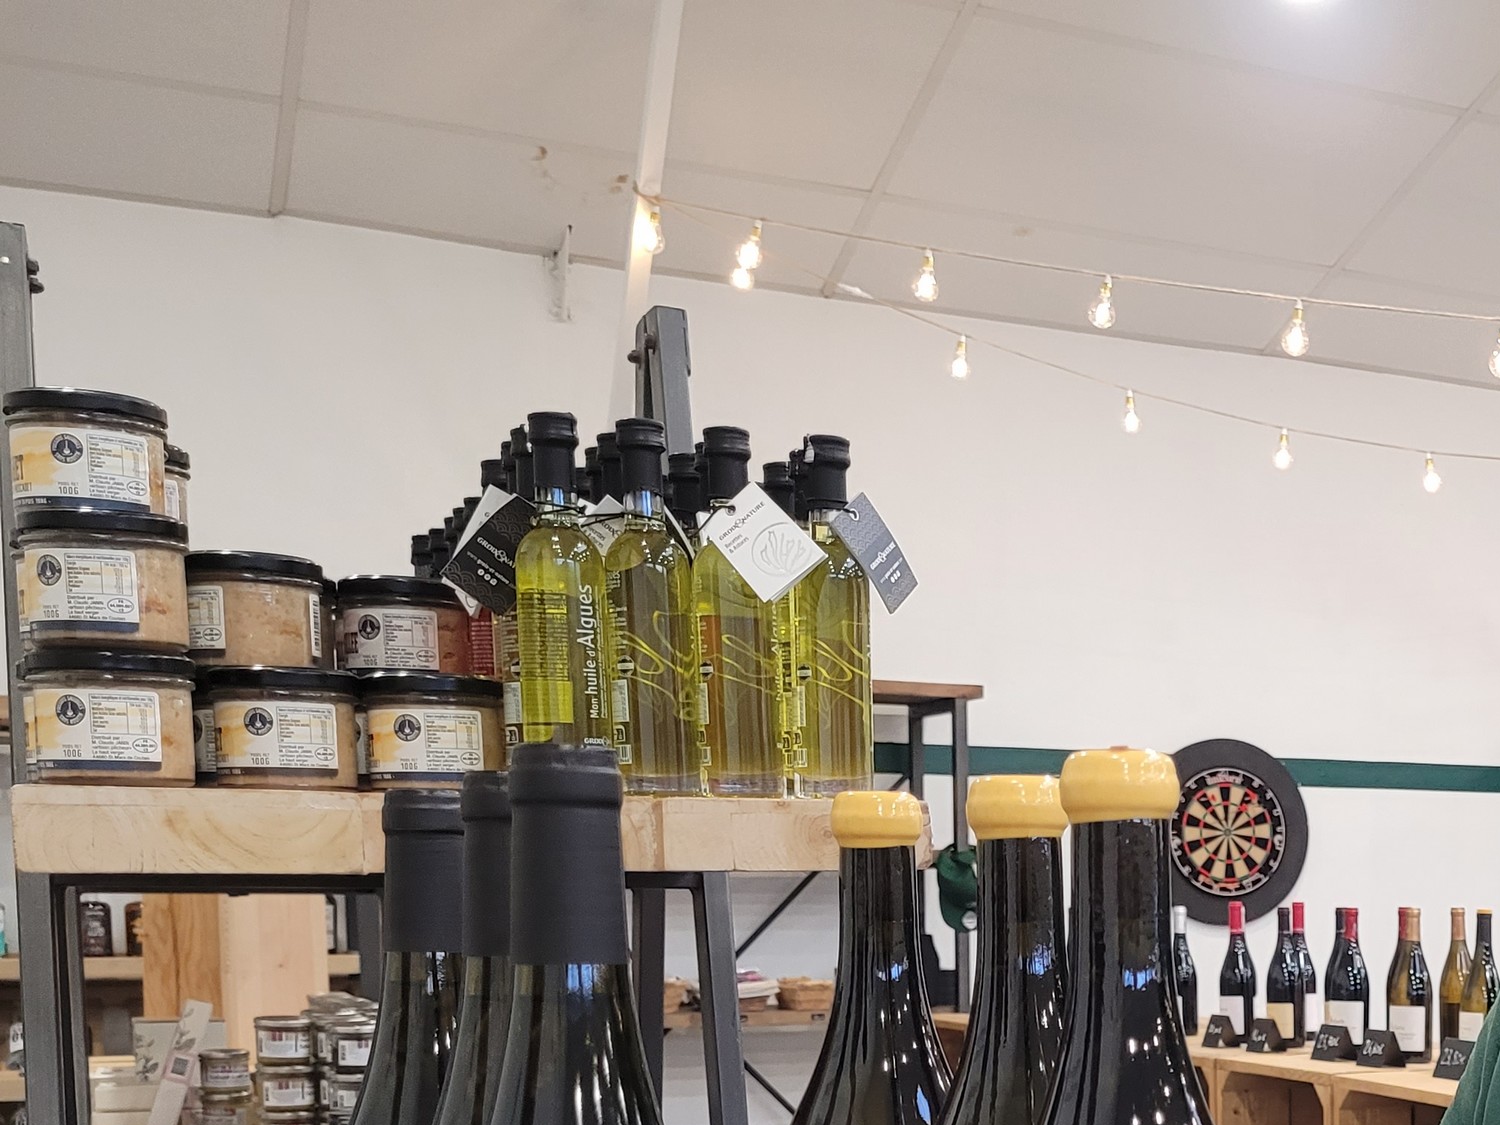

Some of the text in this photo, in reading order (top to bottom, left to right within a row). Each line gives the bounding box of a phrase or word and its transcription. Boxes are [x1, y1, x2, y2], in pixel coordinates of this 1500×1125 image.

[59, 486, 79, 495] 100G
[743, 501, 765, 521] NATURE
[43, 610, 60, 618] 100G
[583, 658, 599, 696] huile
[590, 697, 600, 719] Mon
[63, 749, 82, 758] 100G
[251, 757, 270, 765] 100G
[400, 762, 418, 770] 100G
